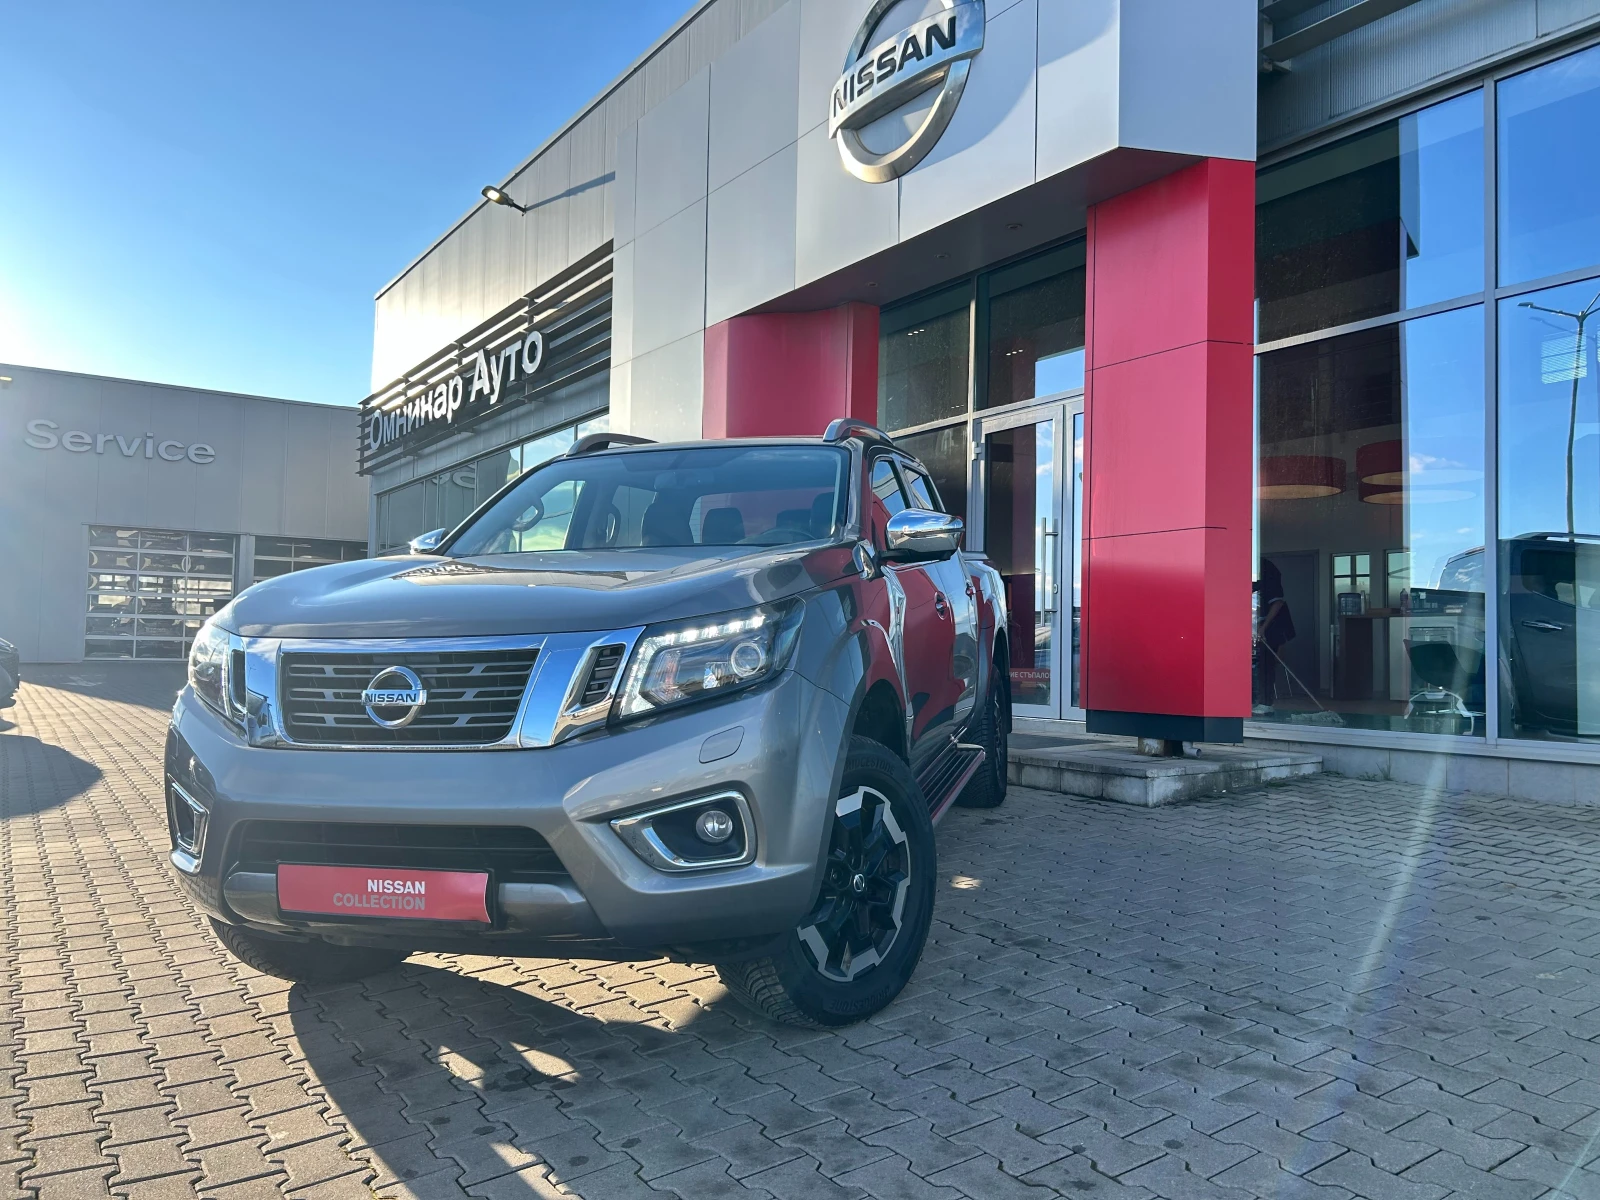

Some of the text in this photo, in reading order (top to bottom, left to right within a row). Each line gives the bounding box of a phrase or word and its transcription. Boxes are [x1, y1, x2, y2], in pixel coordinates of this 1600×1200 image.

[833, 15, 957, 118] NISSAN
[469, 330, 543, 405] Ауто
[24, 418, 216, 464] Service
[364, 693, 417, 703] NISSAN
[333, 893, 426, 911] COLLECTION
[367, 879, 426, 895] NISSAN
